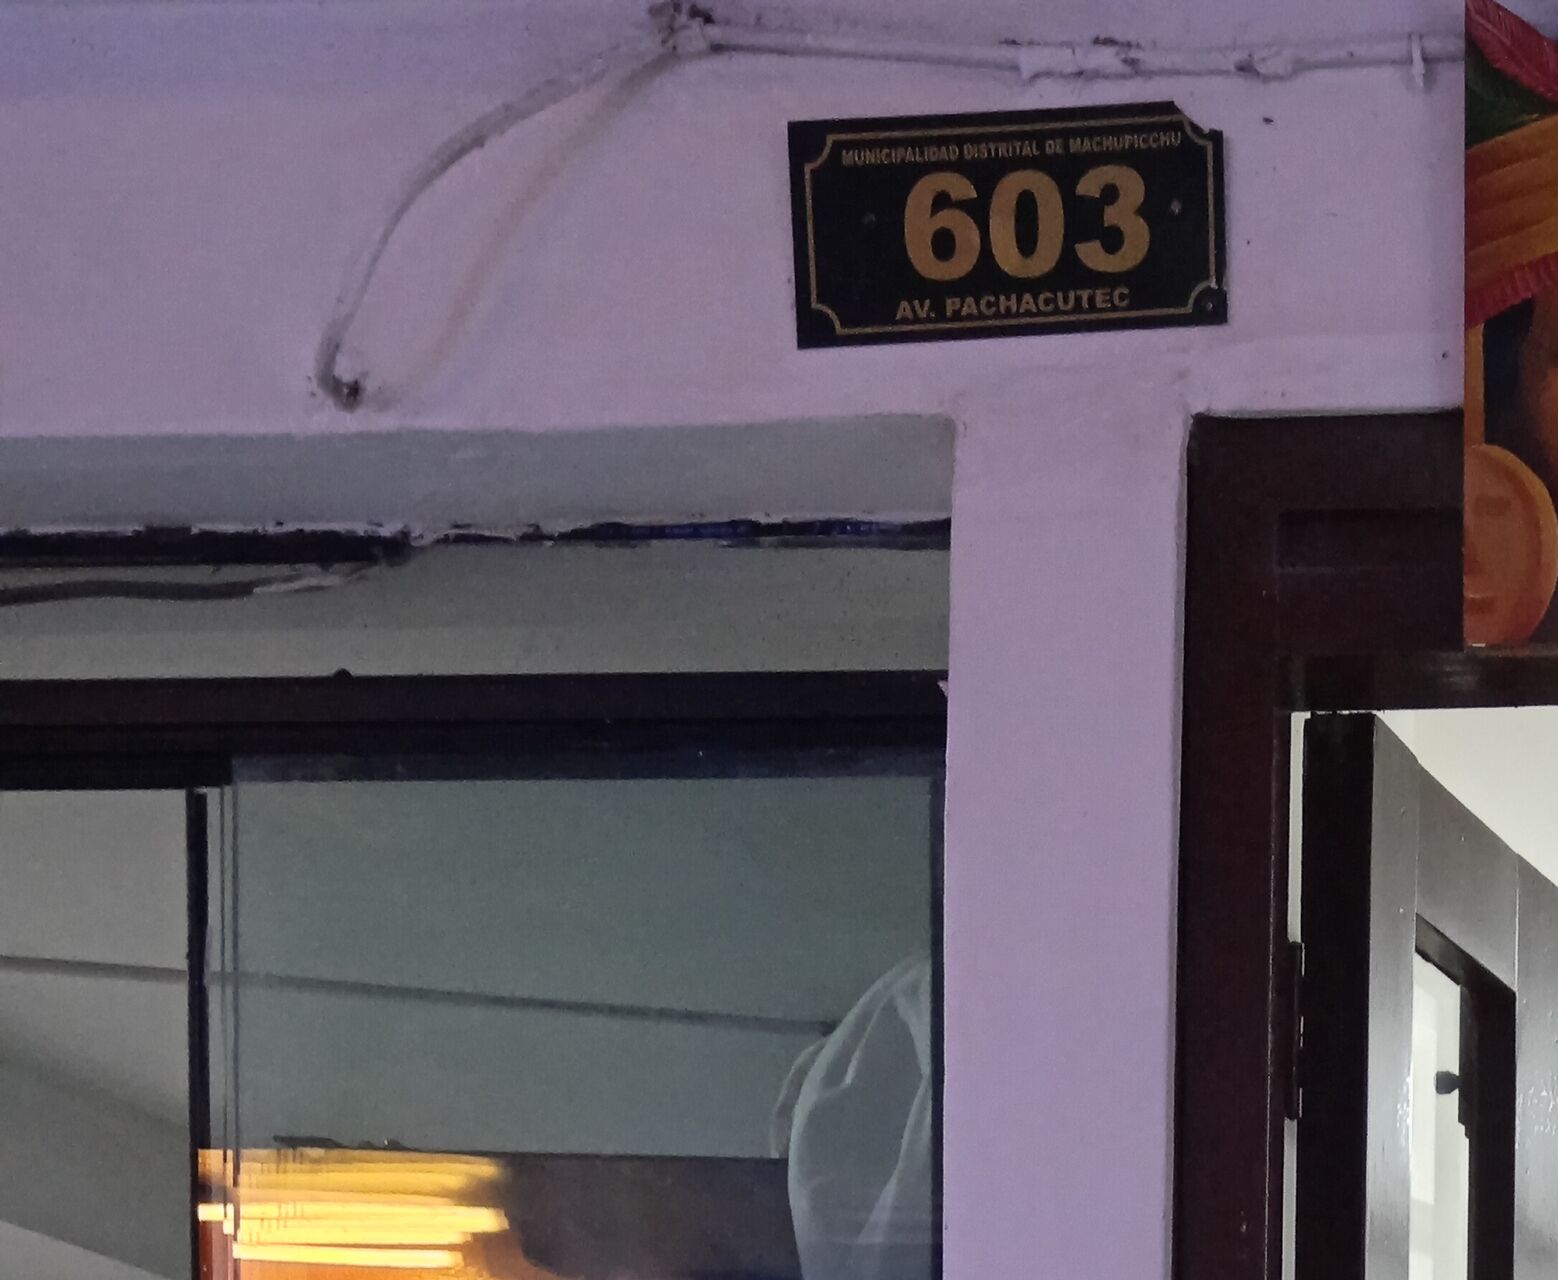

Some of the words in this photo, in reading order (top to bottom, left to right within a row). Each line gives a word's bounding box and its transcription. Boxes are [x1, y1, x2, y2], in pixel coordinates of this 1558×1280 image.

[842, 144, 959, 166] MUNICIPALIDAD
[963, 142, 1040, 161] DISTRITAL
[1045, 139, 1064, 155] DE
[1069, 132, 1182, 153] MACHUPICCHU
[904, 164, 1151, 281] 603
[896, 299, 936, 321] AV.
[945, 287, 1131, 319] PACHACUTEC
